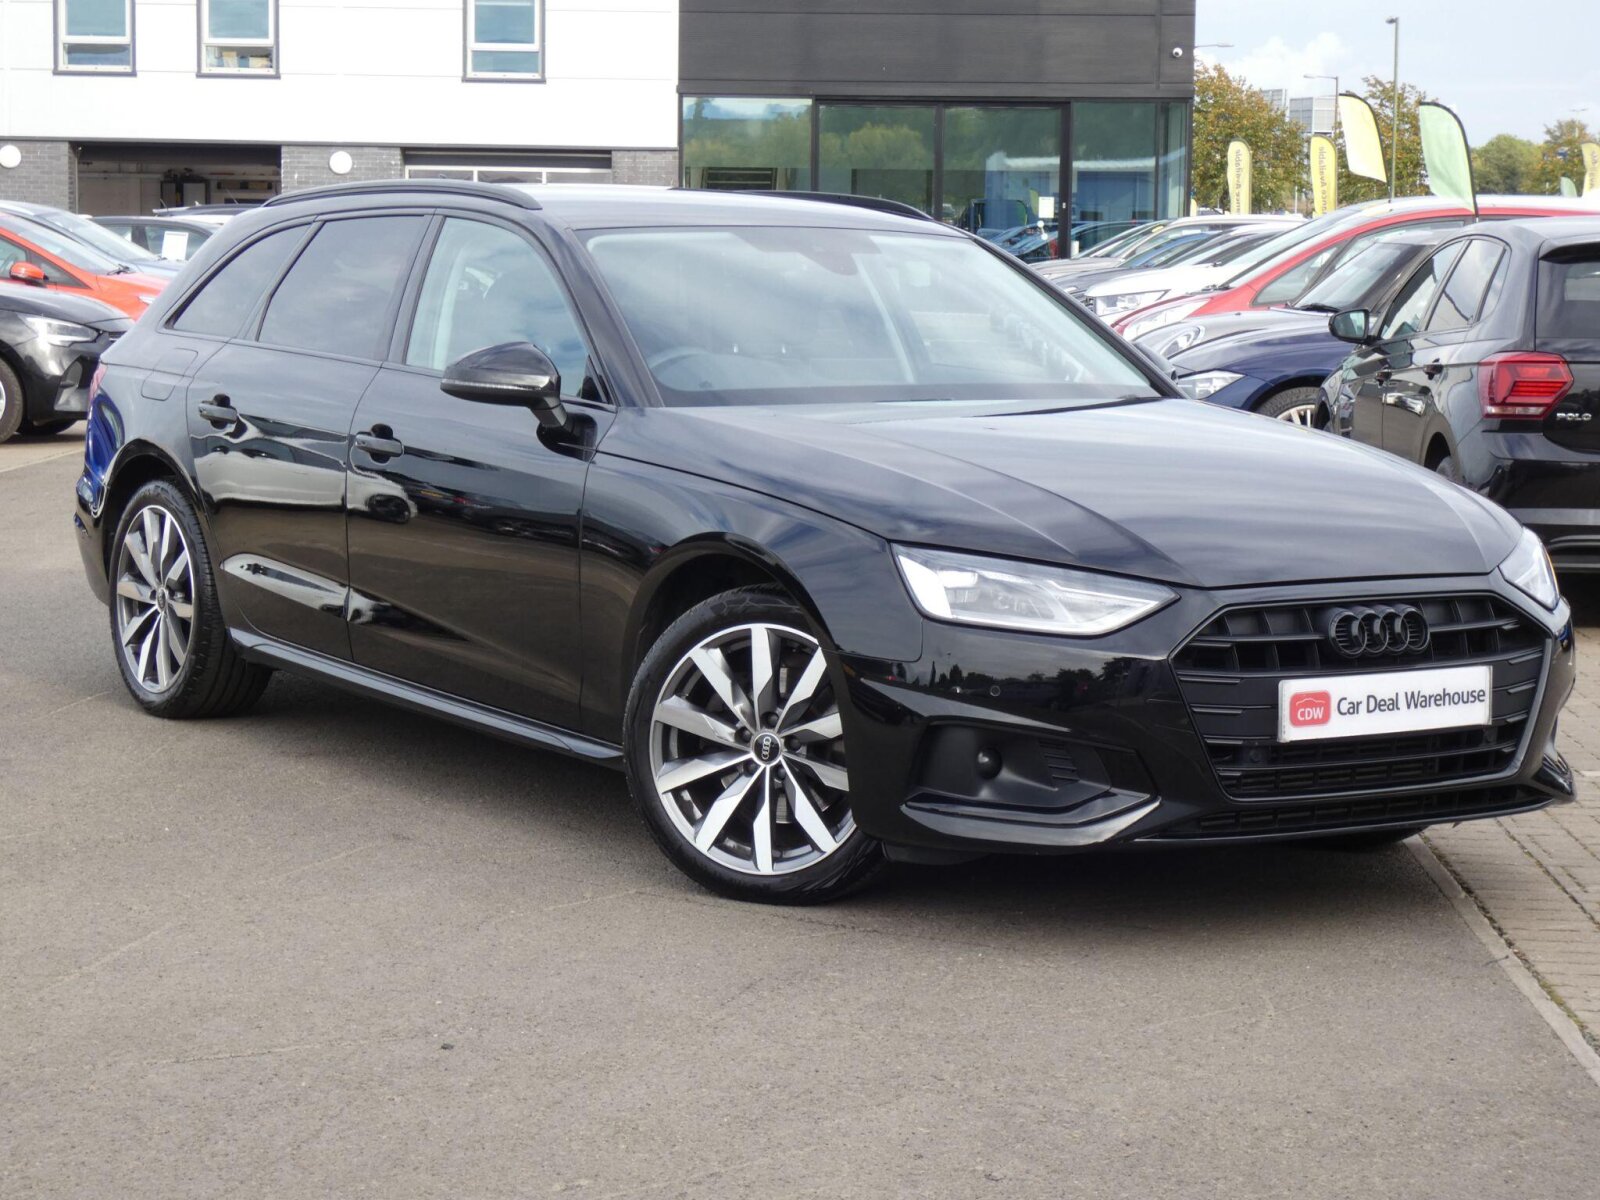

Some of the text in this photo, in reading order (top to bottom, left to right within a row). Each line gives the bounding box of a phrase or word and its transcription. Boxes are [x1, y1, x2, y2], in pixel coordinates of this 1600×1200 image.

[1556, 412, 1592, 421] POLO
[1337, 688, 1486, 716] Car Deal Warehouse
[1297, 707, 1324, 721] CDW
